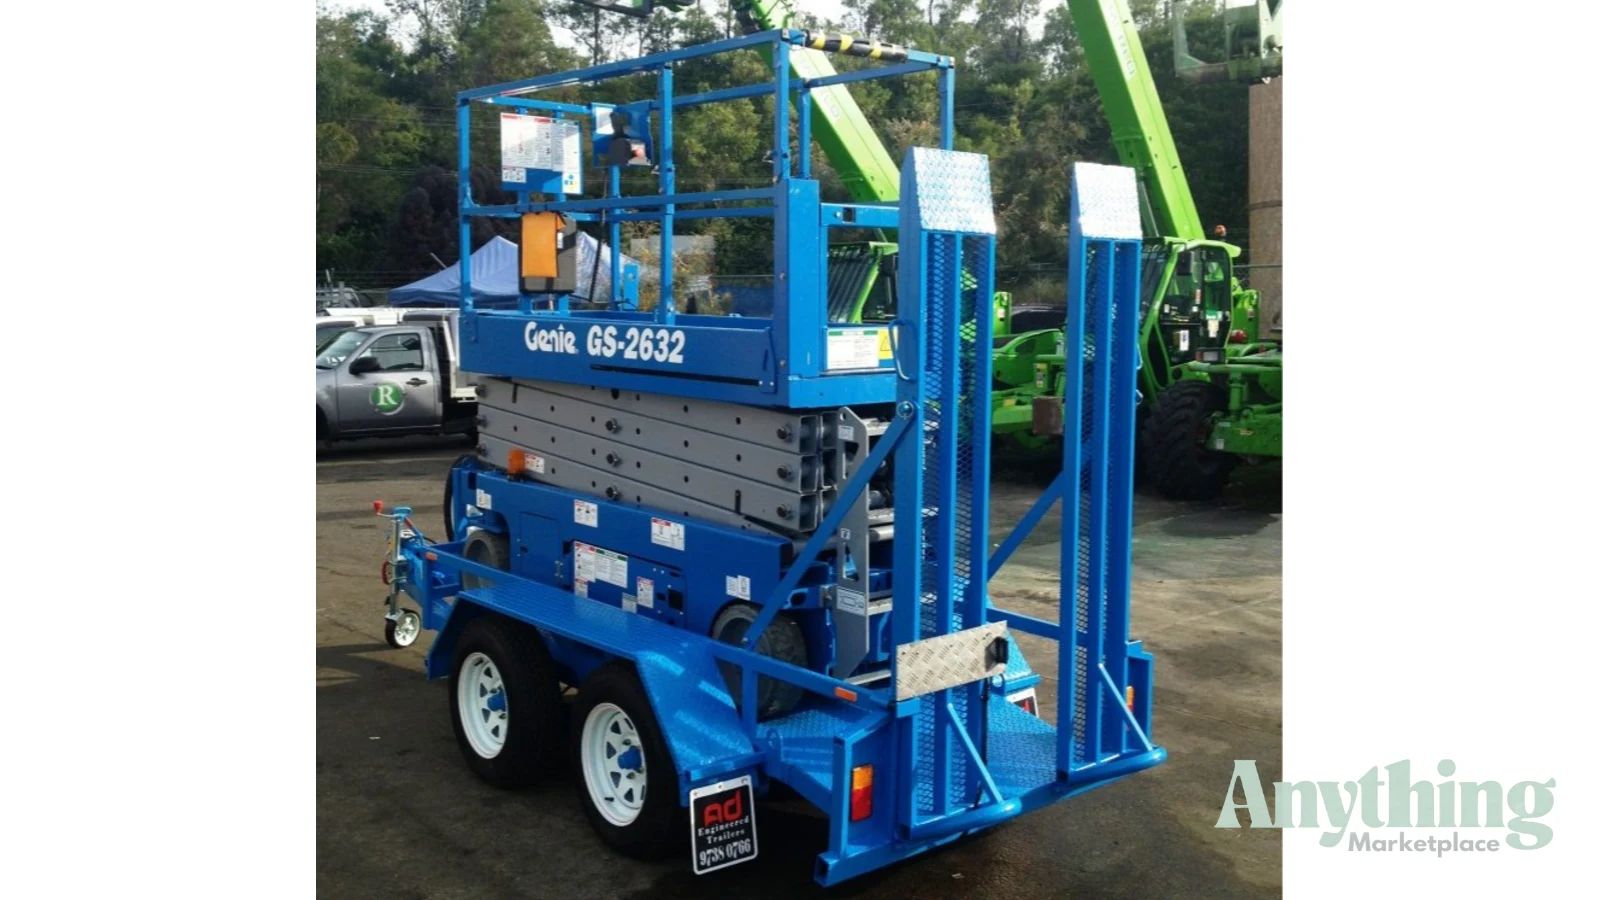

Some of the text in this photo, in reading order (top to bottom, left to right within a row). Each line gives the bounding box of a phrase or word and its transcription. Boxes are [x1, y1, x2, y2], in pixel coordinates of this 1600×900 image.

[524, 321, 686, 364] Genie GS-2632
[376, 386, 399, 406] R
[698, 815, 750, 837] Engineered
[706, 829, 745, 845] Trailers
[699, 838, 751, 867] 9738 0766
